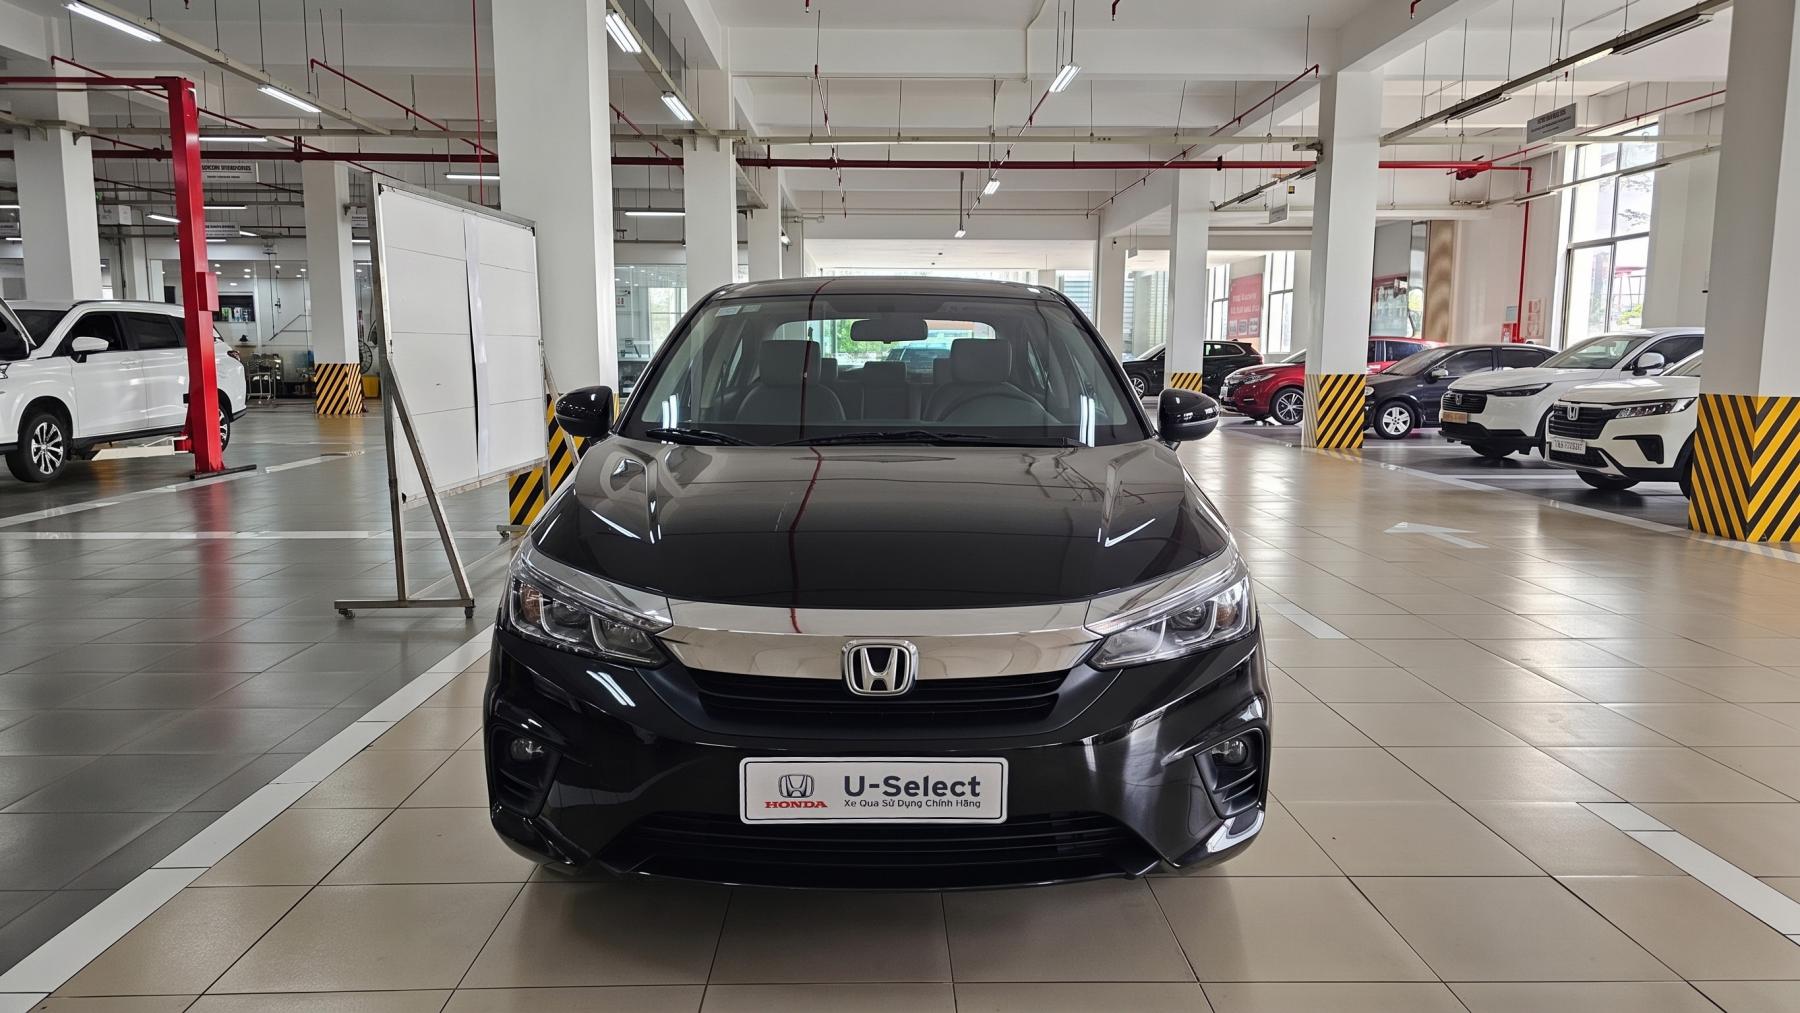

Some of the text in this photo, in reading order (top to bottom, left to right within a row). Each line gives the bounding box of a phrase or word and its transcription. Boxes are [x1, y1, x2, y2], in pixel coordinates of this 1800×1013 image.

[844, 775, 981, 798] U-Select
[764, 800, 828, 809] HONDA
[844, 799, 857, 808] Xe
[859, 799, 879, 808] Qua
[881, 798, 896, 808] Sử
[897, 799, 923, 809] Dụng
[925, 798, 953, 808] Chính
